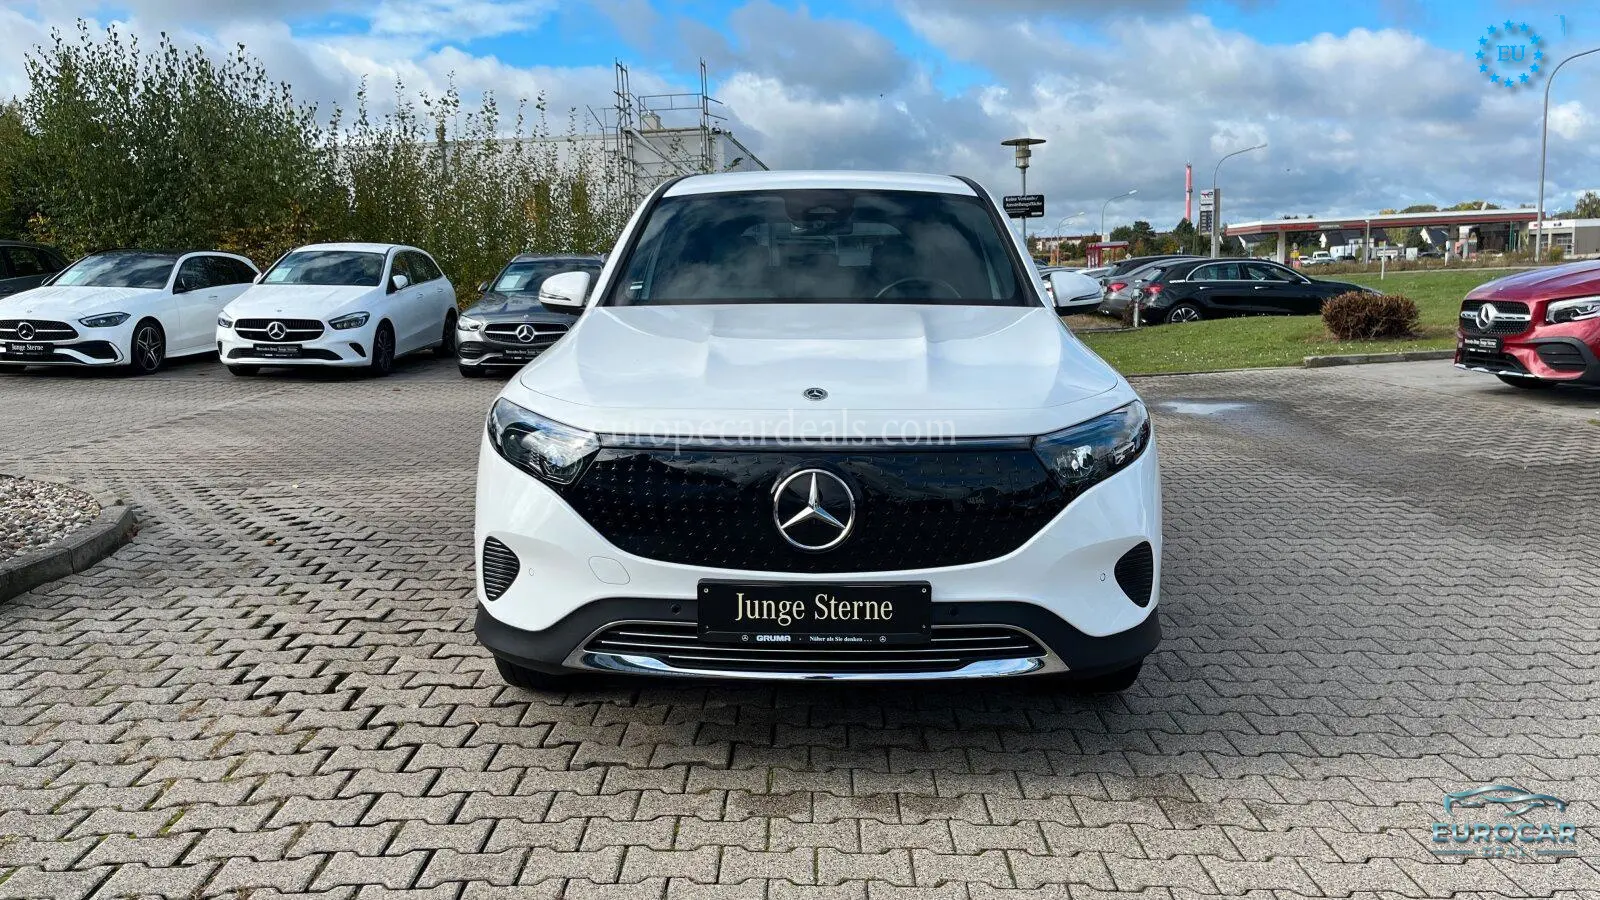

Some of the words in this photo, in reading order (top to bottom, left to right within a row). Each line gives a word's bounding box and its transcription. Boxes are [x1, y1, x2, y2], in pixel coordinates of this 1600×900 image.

[26, 343, 44, 351] Sterne
[735, 592, 805, 626] Junge
[814, 593, 893, 620] Sterne
[756, 634, 791, 642] GRUMA
